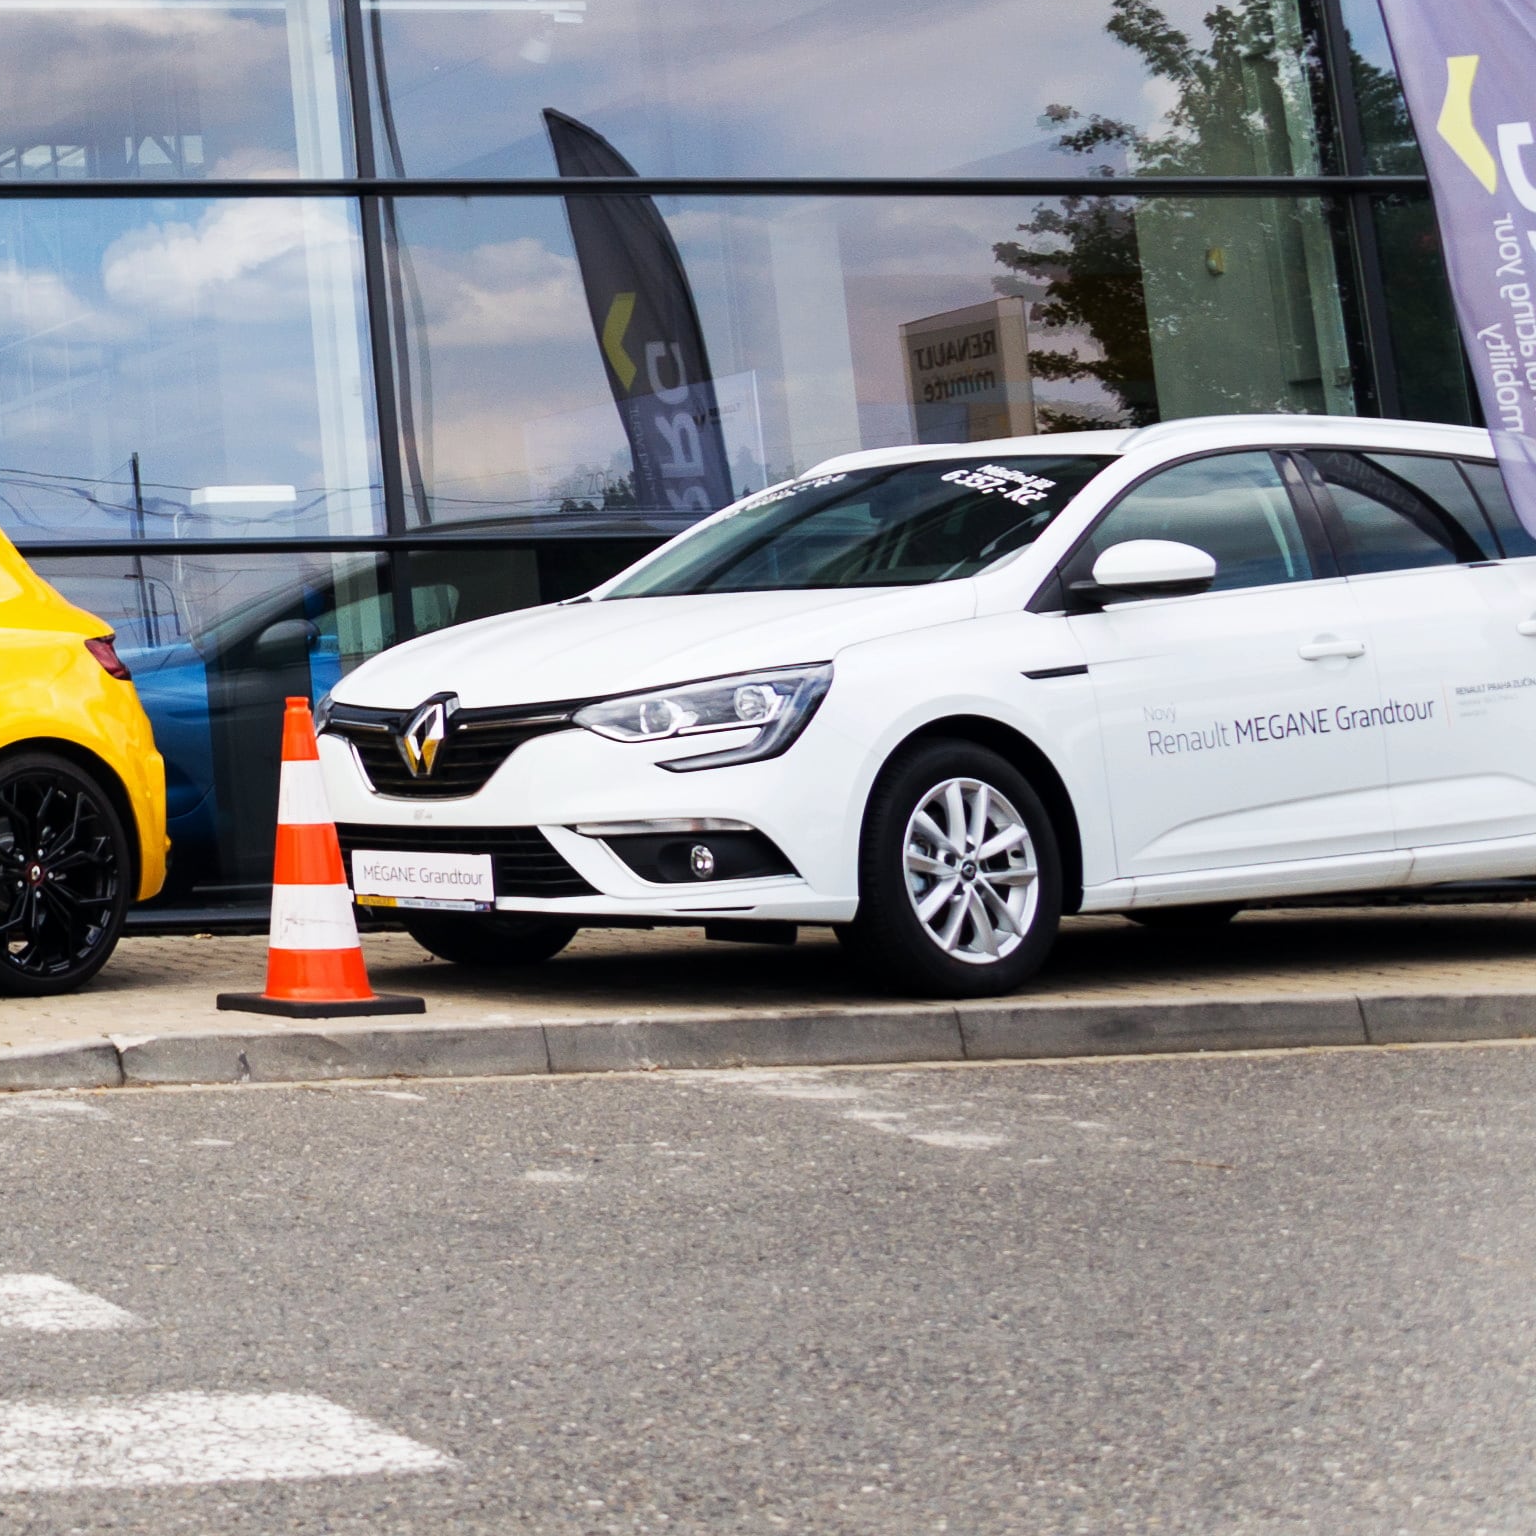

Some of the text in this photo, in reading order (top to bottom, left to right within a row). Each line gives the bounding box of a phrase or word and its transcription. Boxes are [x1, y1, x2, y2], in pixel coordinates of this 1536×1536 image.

[1143, 702, 1176, 723] Nový
[1147, 698, 1435, 757] Renault MEGANE Grandtour
[419, 867, 483, 885] Grandtour
